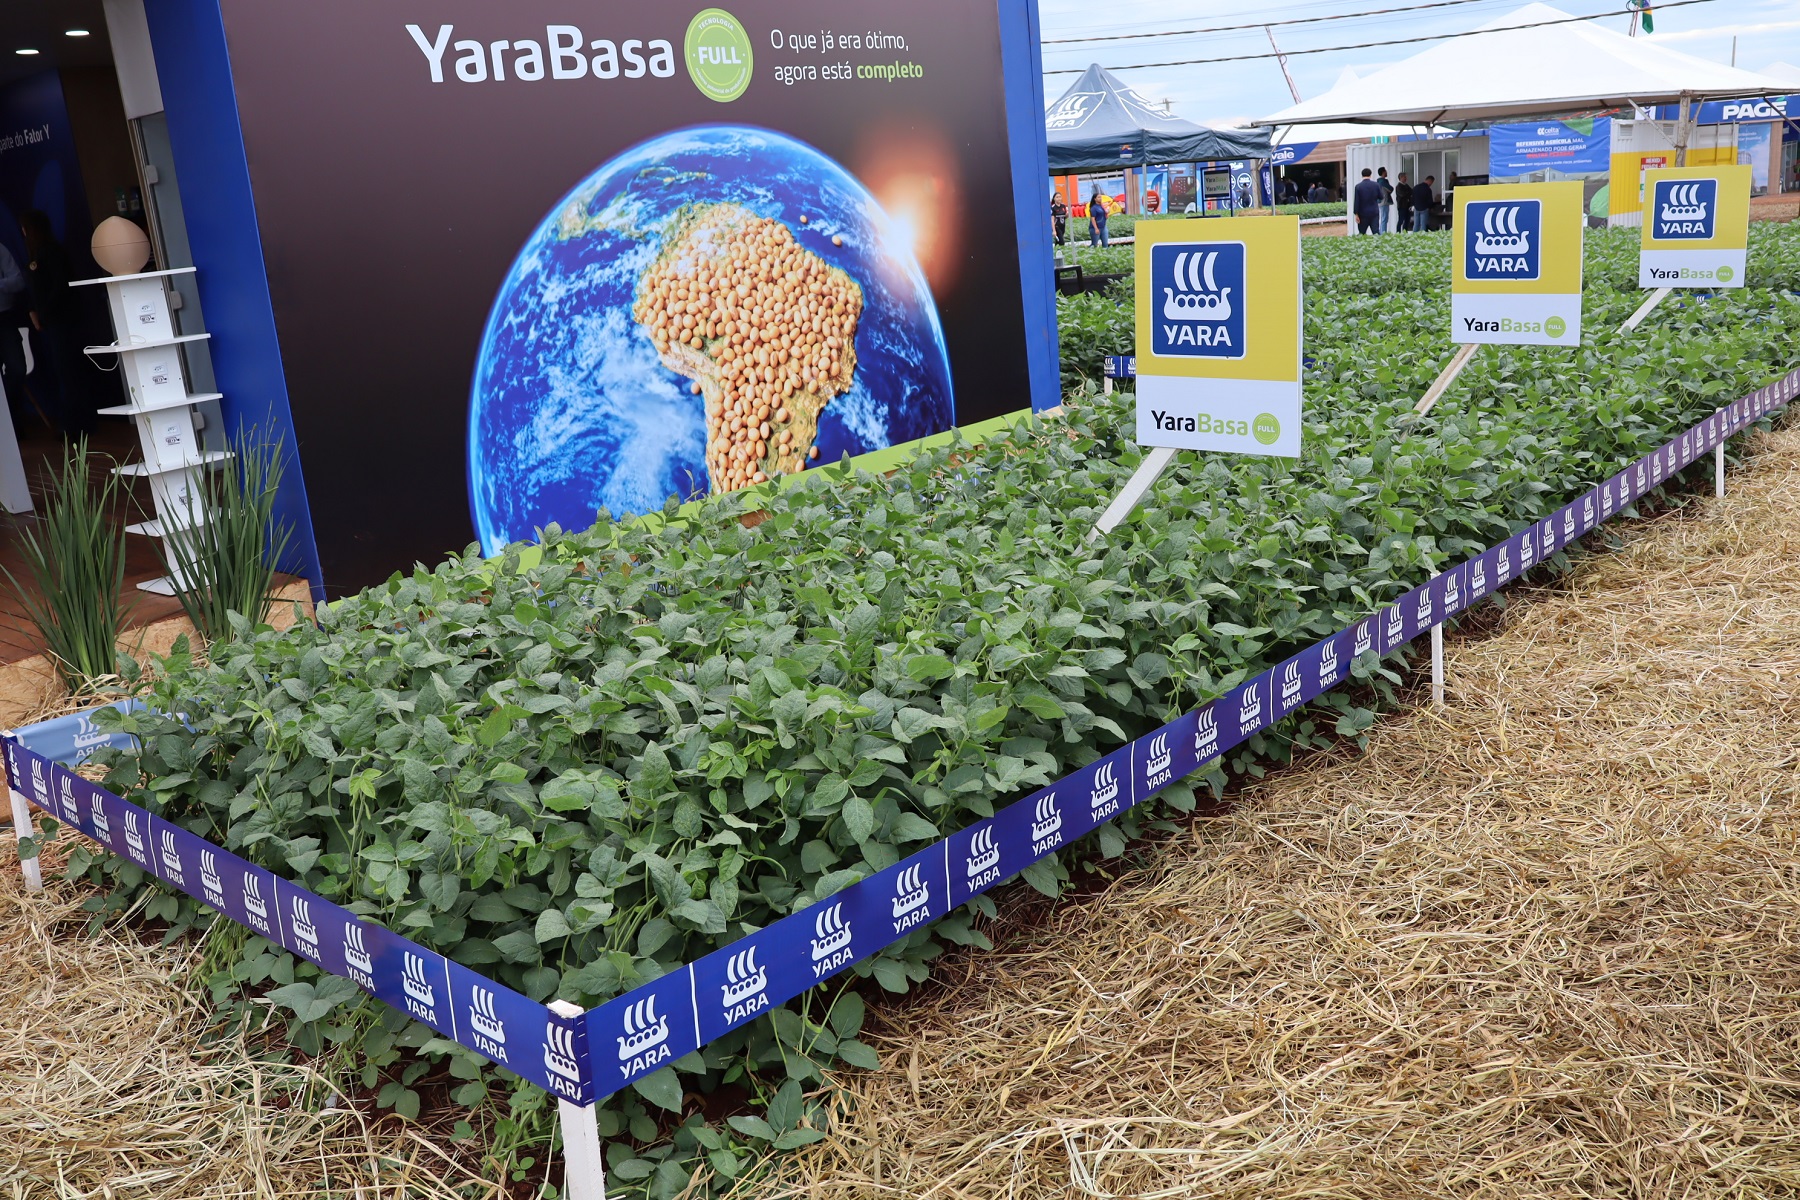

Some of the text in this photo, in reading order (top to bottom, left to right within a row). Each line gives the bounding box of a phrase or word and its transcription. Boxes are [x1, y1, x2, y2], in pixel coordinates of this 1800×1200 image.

[698, 18, 734, 31] TECNOLOGIA
[770, 29, 909, 53] O que já era ótimo,
[405, 24, 676, 82] YaraBasa
[698, 46, 742, 64] FULL
[774, 60, 924, 86] agora está completo
[1722, 97, 1787, 120] PAGÉ
[1046, 119, 1076, 128] ARA
[15, 132, 24, 147] do
[24, 128, 44, 144] Fator
[42, 124, 50, 140] Y
[1660, 222, 1706, 234] YARA
[1474, 258, 1529, 272] YARA
[1650, 268, 1714, 279] YaraBasa
[1163, 324, 1232, 347] YARA
[1464, 318, 1541, 333] YaraBasa
[1151, 410, 1248, 436] YaraBasa
[1498, 572, 1510, 584] YARA
[1472, 586, 1486, 600] YARA
[1444, 602, 1459, 616] YARA
[1417, 616, 1432, 630] YARA
[1388, 632, 1404, 648] YARA
[1319, 670, 1338, 689] YARA
[1282, 694, 1302, 711] YARA
[1240, 716, 1262, 736] YARA
[1194, 742, 1218, 762] YARA
[1146, 768, 1172, 791] YARA
[34, 790, 50, 808] YARA
[64, 808, 80, 826] YARA
[1090, 799, 1119, 823] YARA
[94, 826, 112, 844] YARA
[1032, 831, 1062, 857] YARA
[128, 845, 147, 866] YARA
[164, 866, 186, 887] YARA
[966, 866, 1000, 893] YARA
[204, 887, 226, 910] YARA
[246, 911, 270, 935] YARA
[892, 906, 930, 935] YARA
[294, 936, 322, 963] YARA
[812, 947, 854, 978] YARA
[346, 964, 376, 992] YARA
[404, 994, 438, 1026] YARA
[723, 992, 770, 1026] YARA
[472, 1032, 509, 1064] YARA
[620, 1043, 672, 1080] YARA
